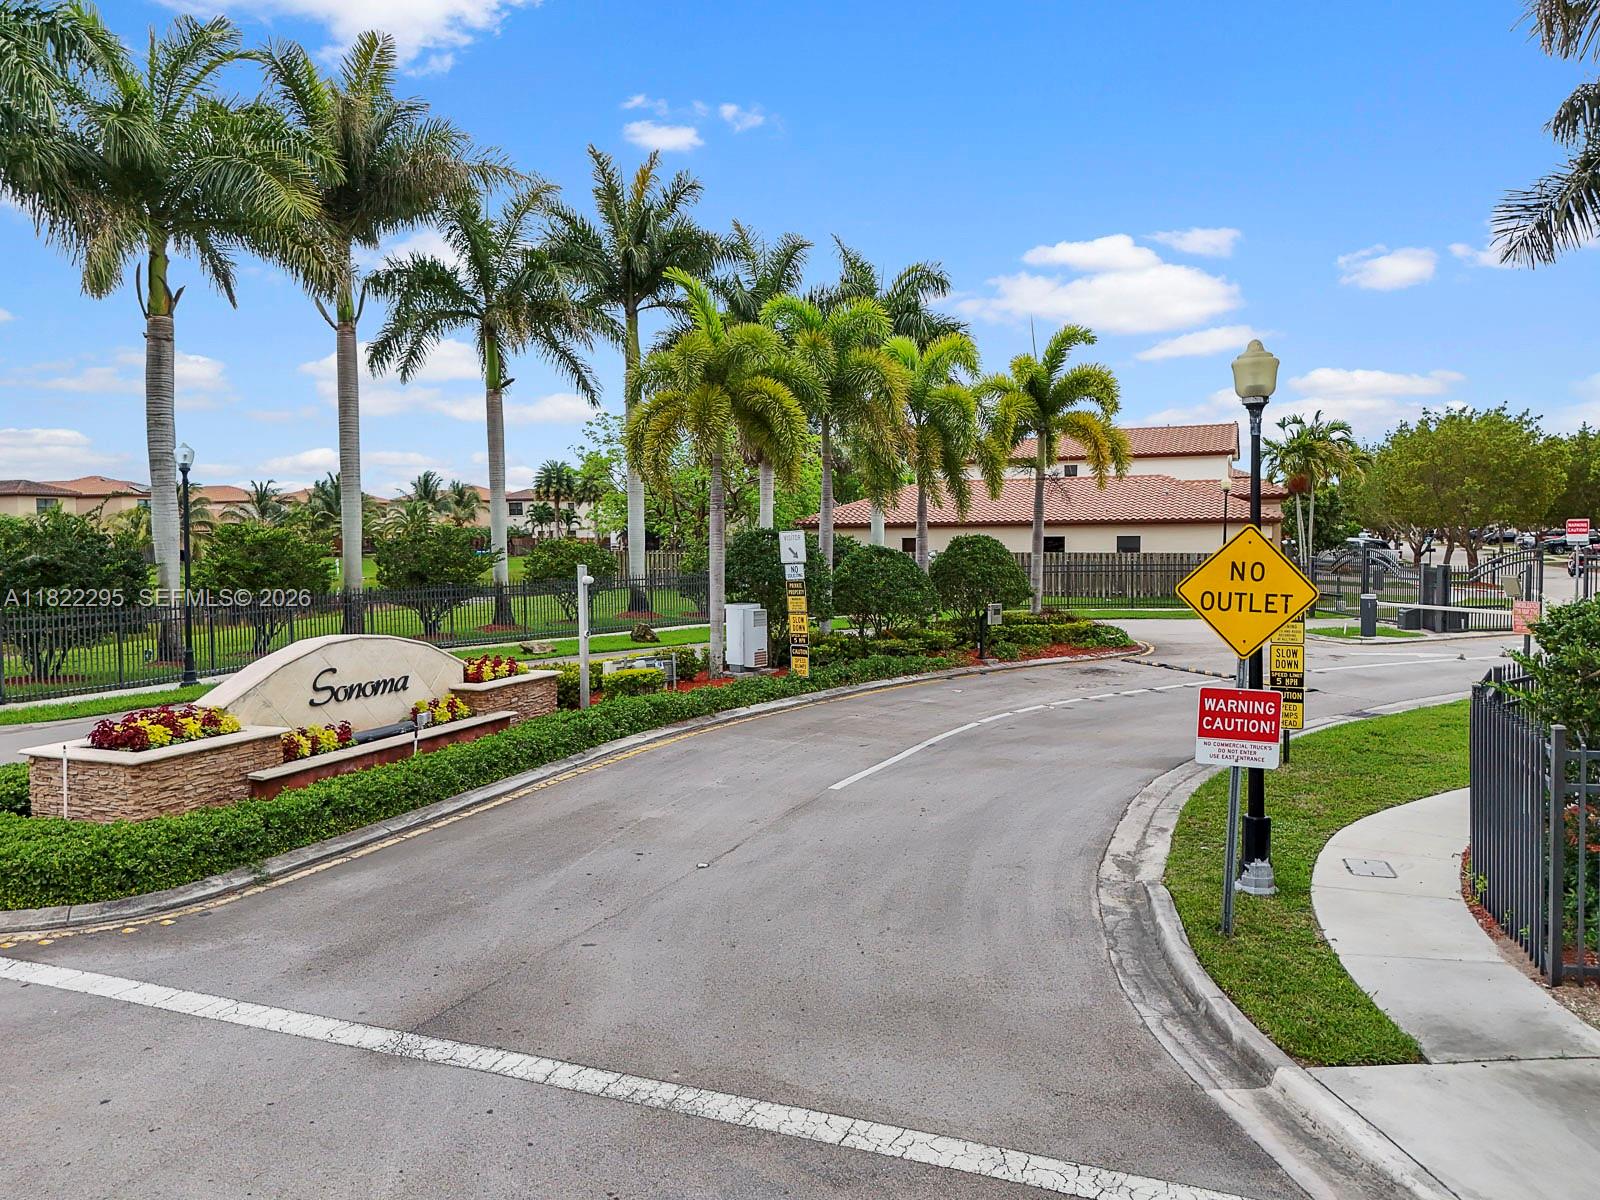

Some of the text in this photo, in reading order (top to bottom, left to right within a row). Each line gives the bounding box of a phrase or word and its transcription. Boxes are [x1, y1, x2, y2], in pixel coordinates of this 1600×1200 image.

[1230, 561, 1266, 582] NO
[1200, 590, 1293, 614] OUTLET
[1276, 648, 1298, 658] SLOW
[1276, 659, 1298, 669] DOWN
[309, 668, 409, 706] Sonoma
[1283, 692, 1302, 700] UTION
[1204, 698, 1276, 714] WARNING
[1202, 716, 1276, 734] CAUTION!
